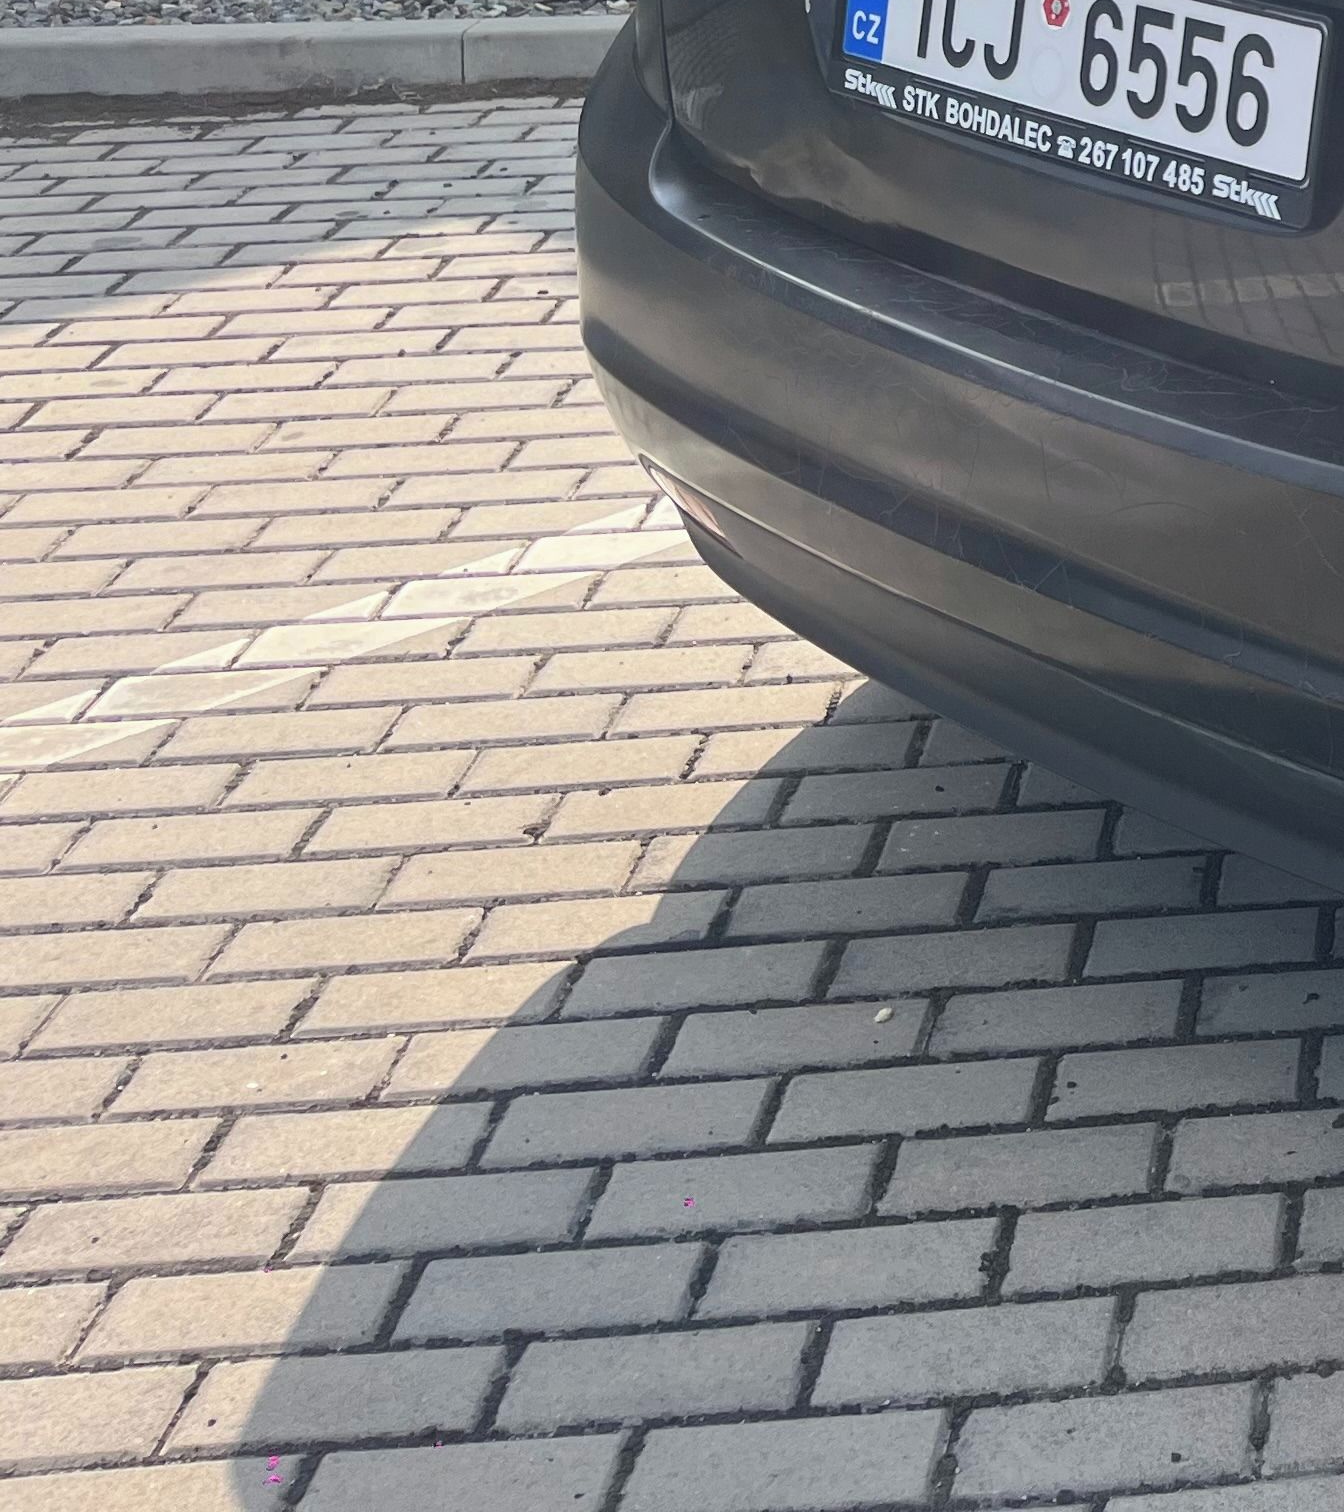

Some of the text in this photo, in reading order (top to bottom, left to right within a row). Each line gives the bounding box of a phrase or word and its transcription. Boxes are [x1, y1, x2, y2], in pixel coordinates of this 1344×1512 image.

[852, 10, 881, 44] CZ
[902, 85, 940, 121] STK
[945, 96, 1053, 153] BOHDALEC
[1078, 136, 1119, 170] 267
[1121, 148, 1160, 182] 107
[1162, 160, 1206, 196] 485
